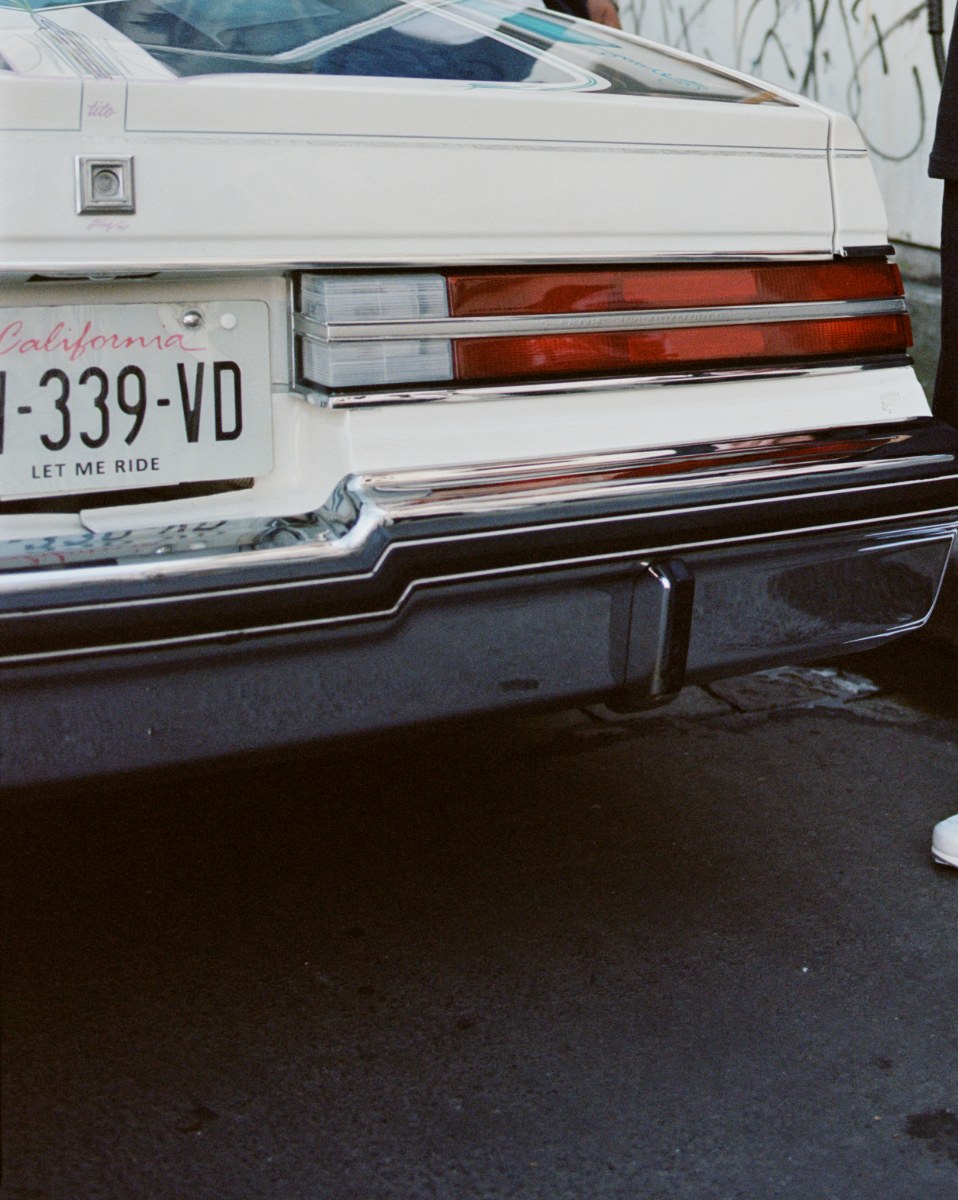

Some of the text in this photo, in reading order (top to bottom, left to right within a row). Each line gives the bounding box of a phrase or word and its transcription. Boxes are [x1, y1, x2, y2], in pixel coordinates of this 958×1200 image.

[0, 320, 207, 361] California
[0, 360, 243, 454] -339-VD
[32, 458, 160, 479] LET ME RIDE
